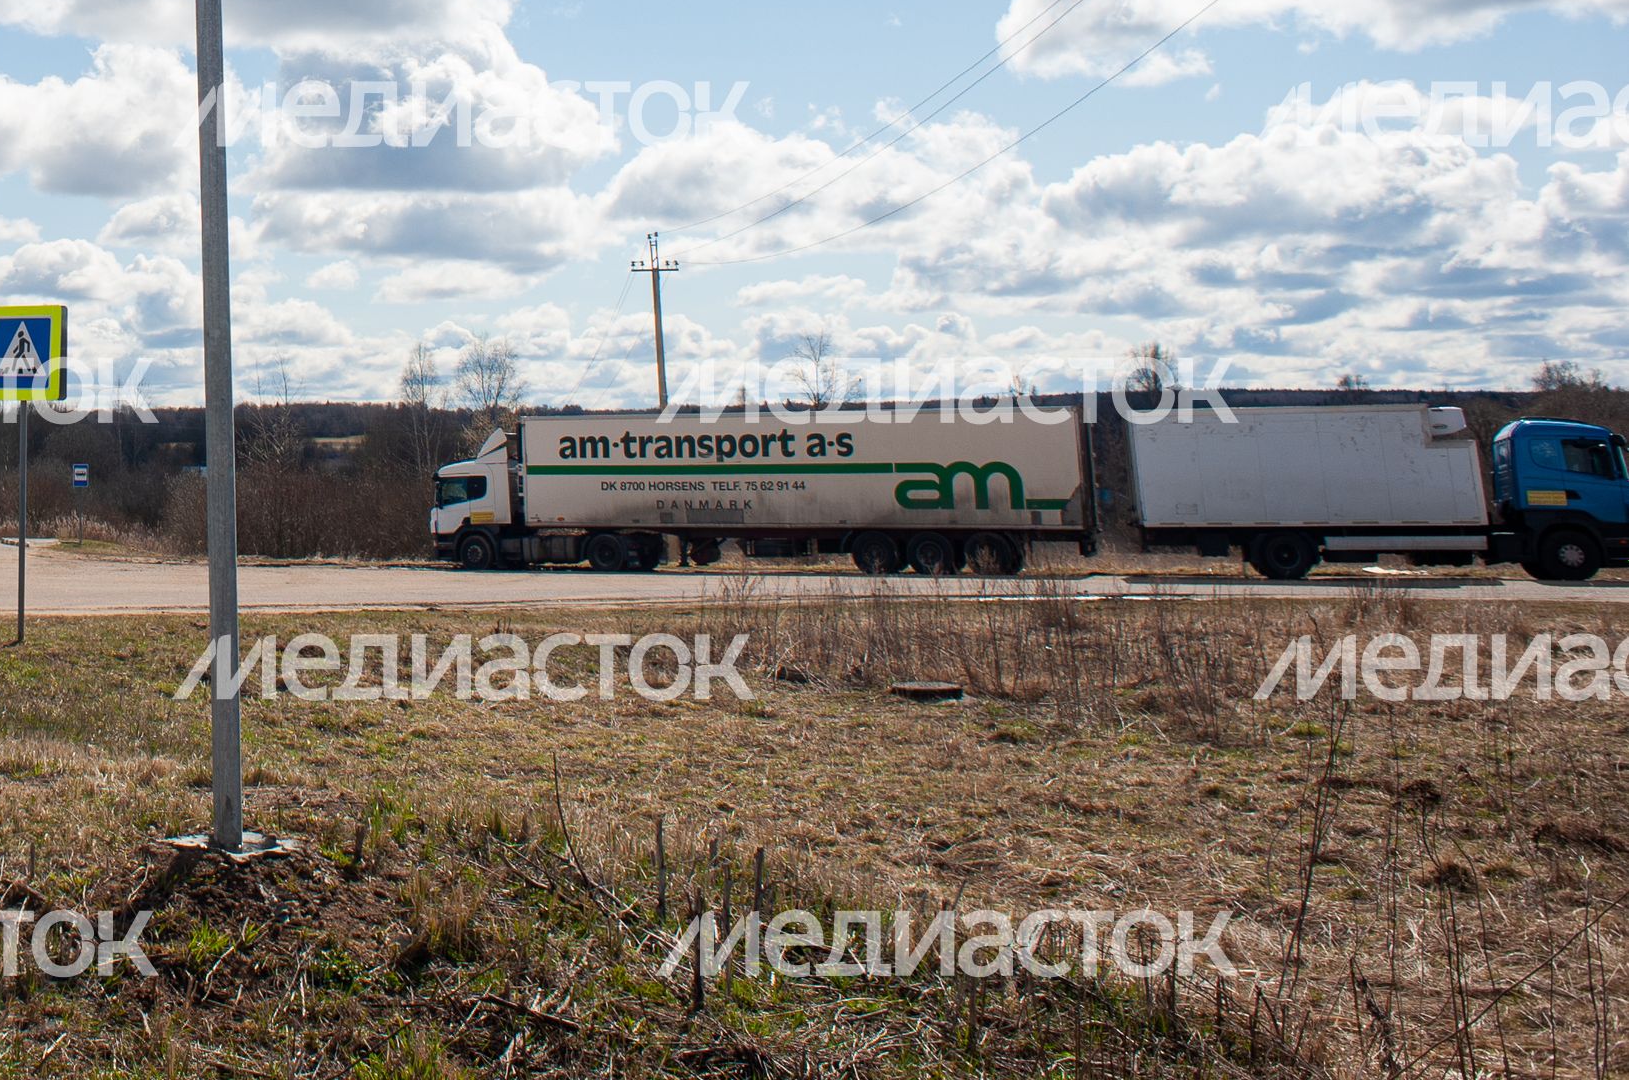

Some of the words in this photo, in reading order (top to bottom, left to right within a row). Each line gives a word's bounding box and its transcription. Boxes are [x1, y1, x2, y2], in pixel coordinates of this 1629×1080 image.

[600, 481, 617, 492] DK
[619, 481, 645, 492] 8700
[648, 481, 705, 492] HORSENS
[745, 481, 758, 492] 75
[760, 481, 774, 492] 62
[776, 481, 789, 492] 91
[791, 481, 806, 492] 44
[894, 461, 1026, 510] am
